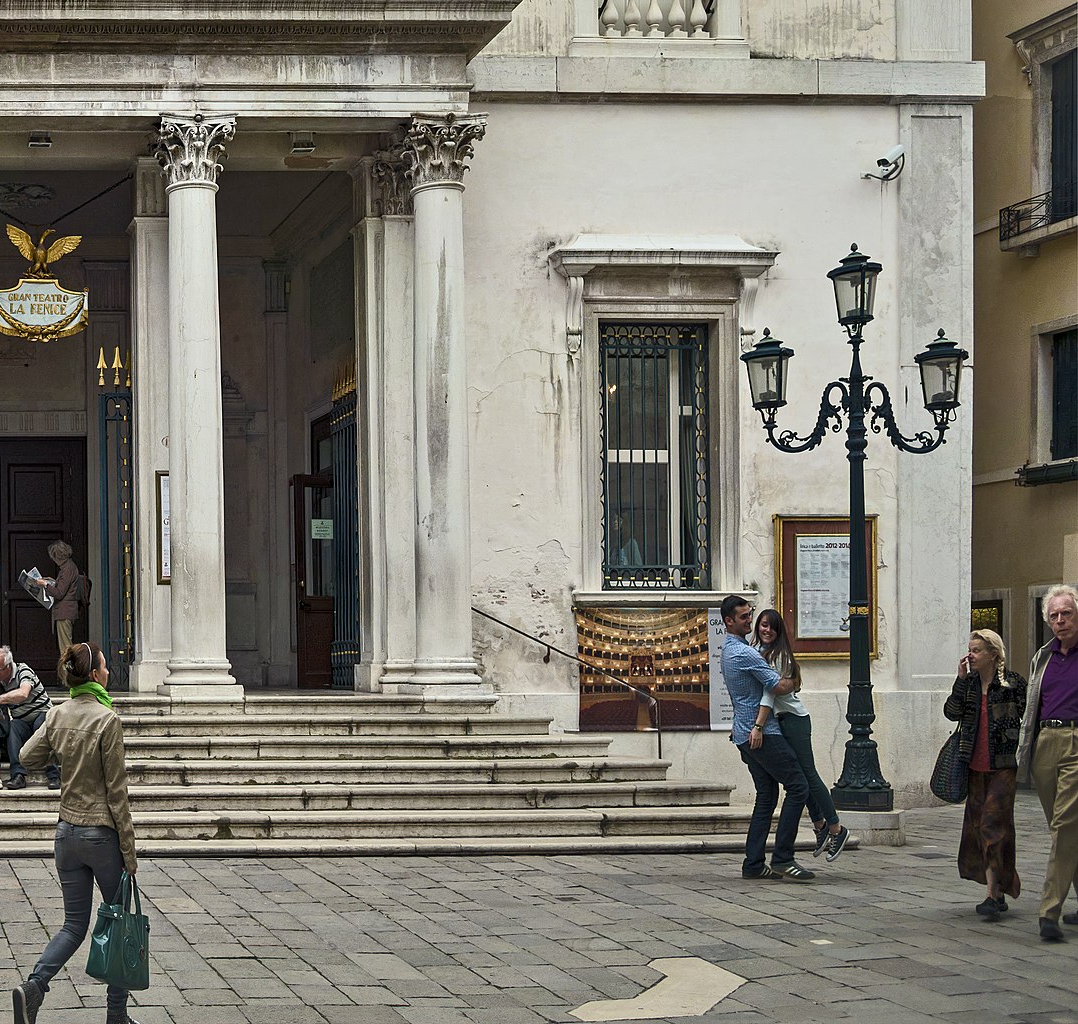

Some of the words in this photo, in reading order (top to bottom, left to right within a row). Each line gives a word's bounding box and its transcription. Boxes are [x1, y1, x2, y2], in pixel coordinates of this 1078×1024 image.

[7, 293, 32, 302] GRAN
[33, 293, 70, 304] TEATRO
[9, 302, 26, 315] LA
[30, 303, 67, 316] FENICE
[709, 618, 724, 626] GRA
[715, 627, 723, 635] LA
